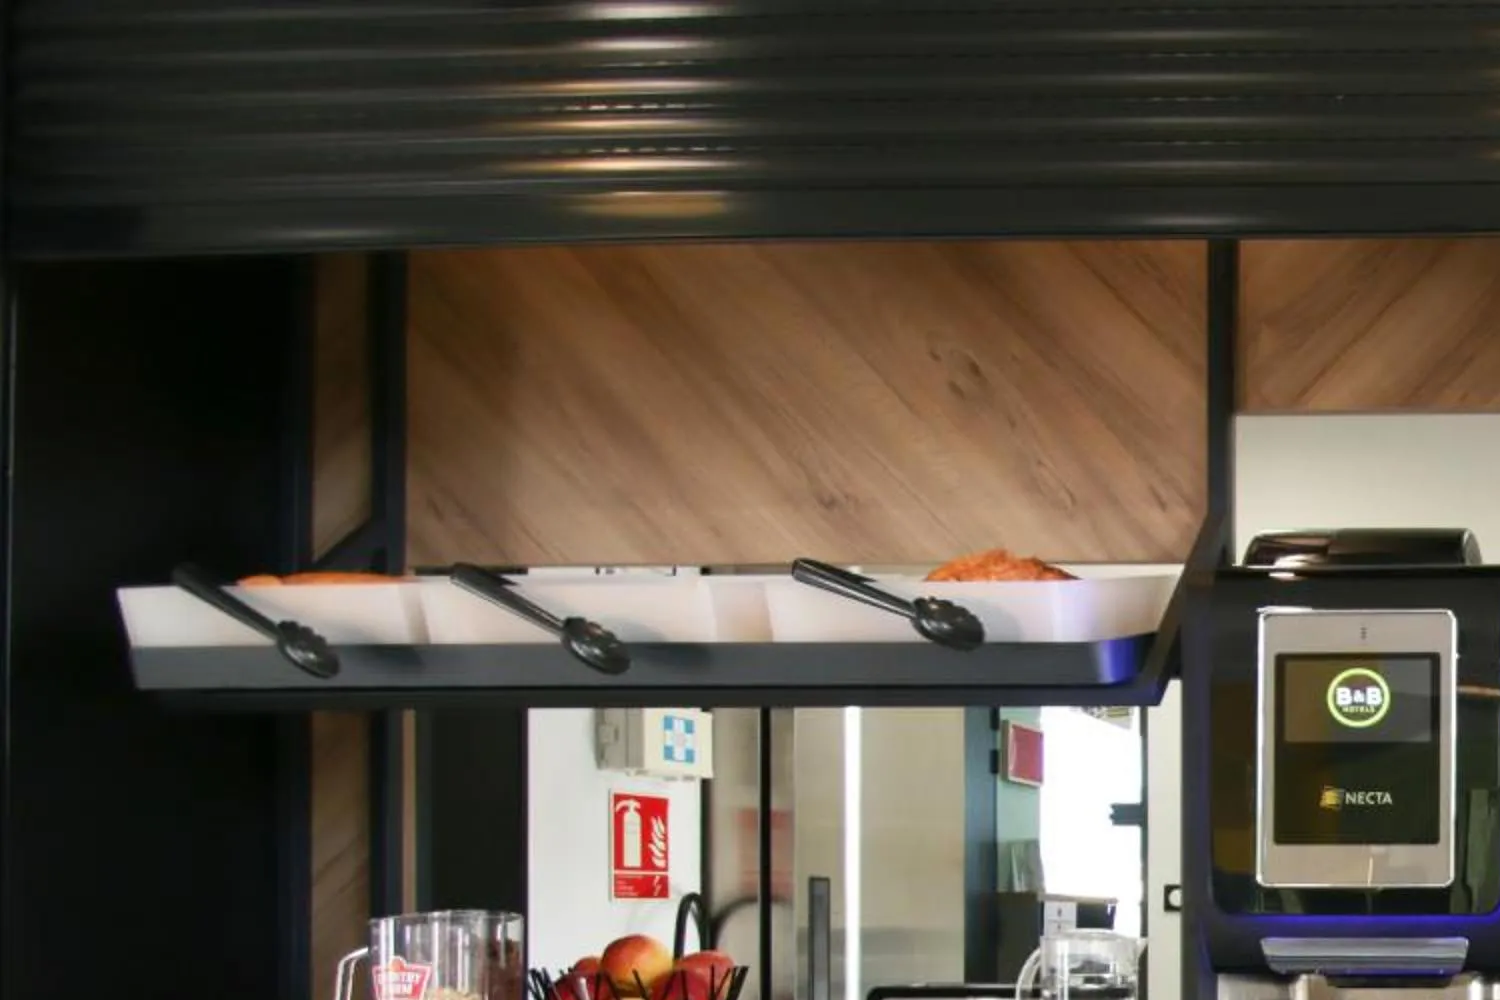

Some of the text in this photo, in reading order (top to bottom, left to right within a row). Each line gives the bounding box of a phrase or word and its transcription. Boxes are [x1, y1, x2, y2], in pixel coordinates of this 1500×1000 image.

[1336, 687, 1382, 705] B&B
[1342, 705, 1375, 713] HOTELS
[1345, 791, 1393, 805] NECTA
